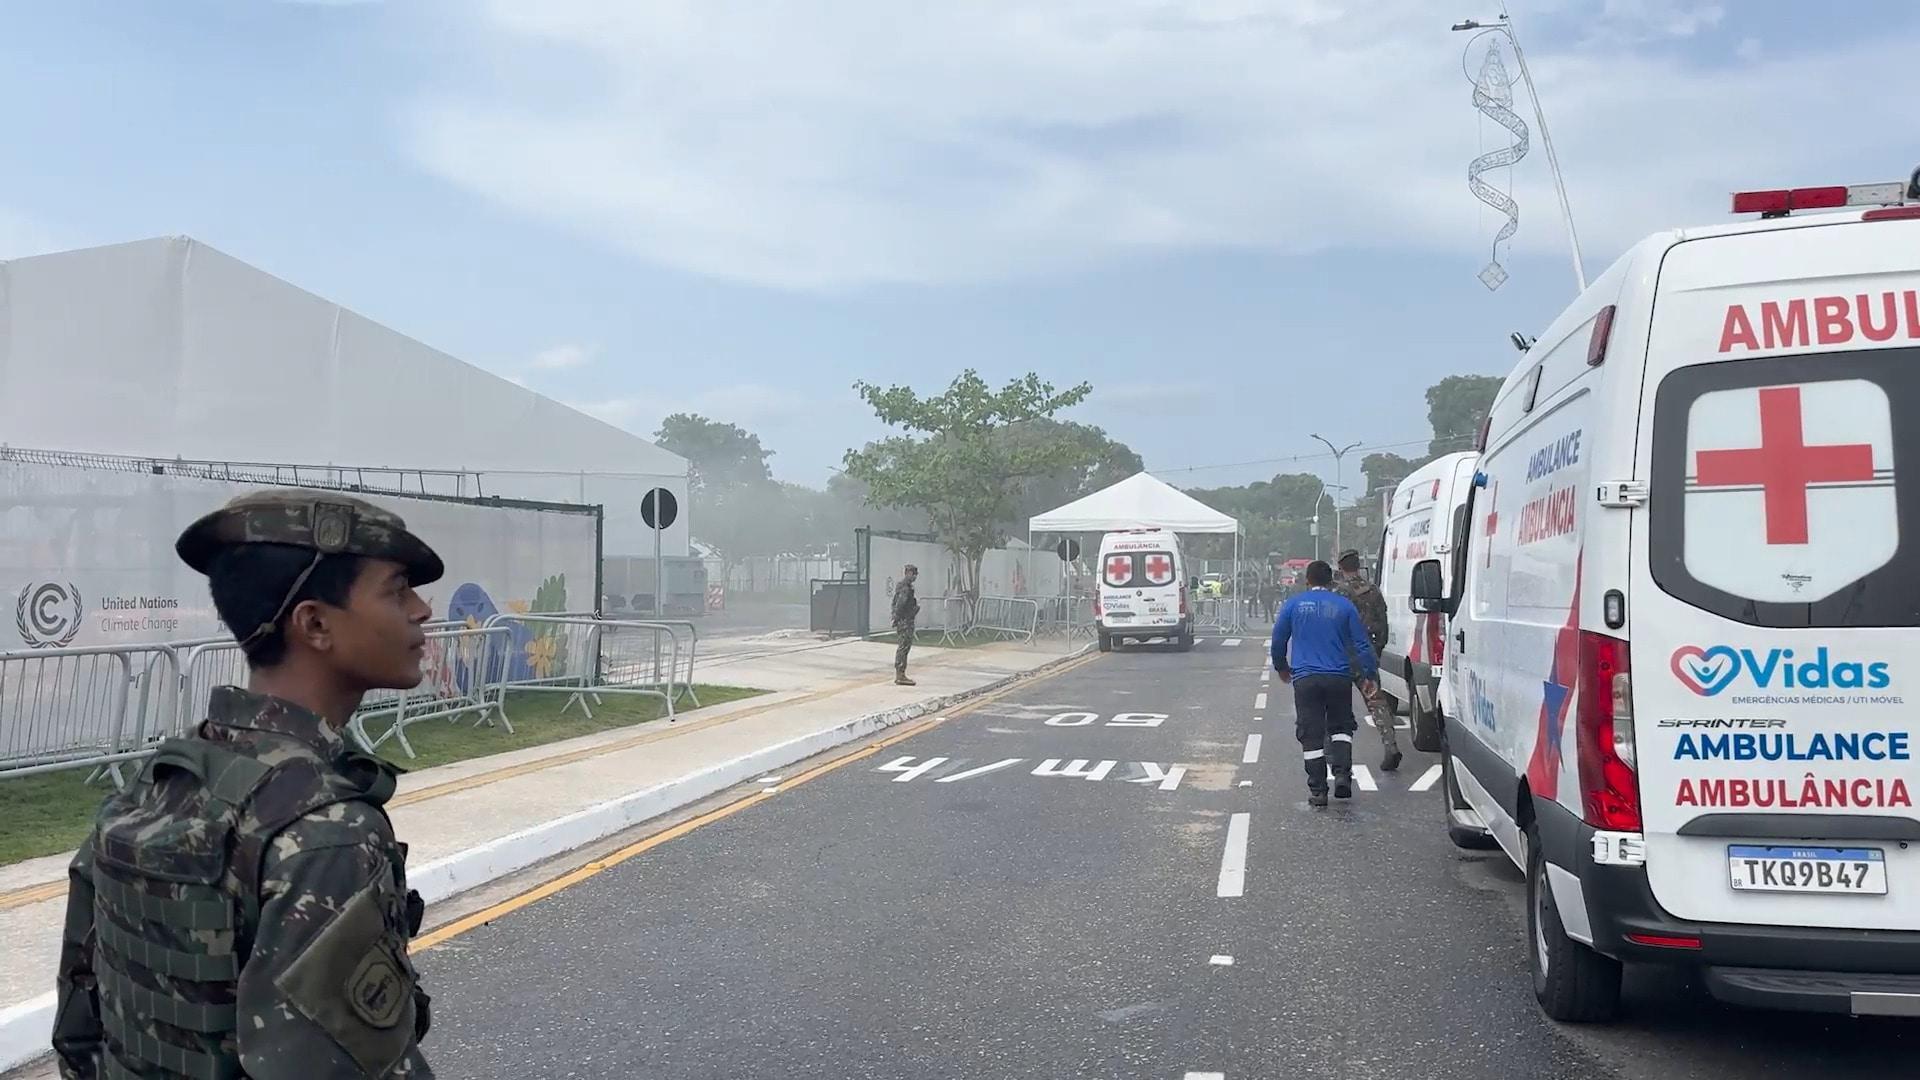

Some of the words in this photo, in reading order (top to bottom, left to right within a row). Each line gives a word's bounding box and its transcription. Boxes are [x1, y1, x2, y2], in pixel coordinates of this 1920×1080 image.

[1718, 290, 1920, 353] AMBUL
[1525, 429, 1582, 484] AMBULANCE
[1517, 482, 1576, 547] AMBULÂNCIA
[102, 596, 136, 610] United
[140, 596, 178, 609] Nations
[101, 618, 139, 632] Climate
[142, 617, 178, 632] Change
[1739, 646, 1891, 688] Vidas
[1731, 695, 1800, 704] EMERGÊNCIAS
[1802, 695, 1846, 704] MÉDICAS
[1043, 712, 1169, 727] 50
[1657, 718, 1787, 728] SPRINTER
[1673, 732, 1910, 760] AMBULANCE
[1675, 772, 1912, 807] AMBULÂNCIA
[1733, 878, 1743, 887] BR
[1743, 859, 1869, 888] TKQ9B47
